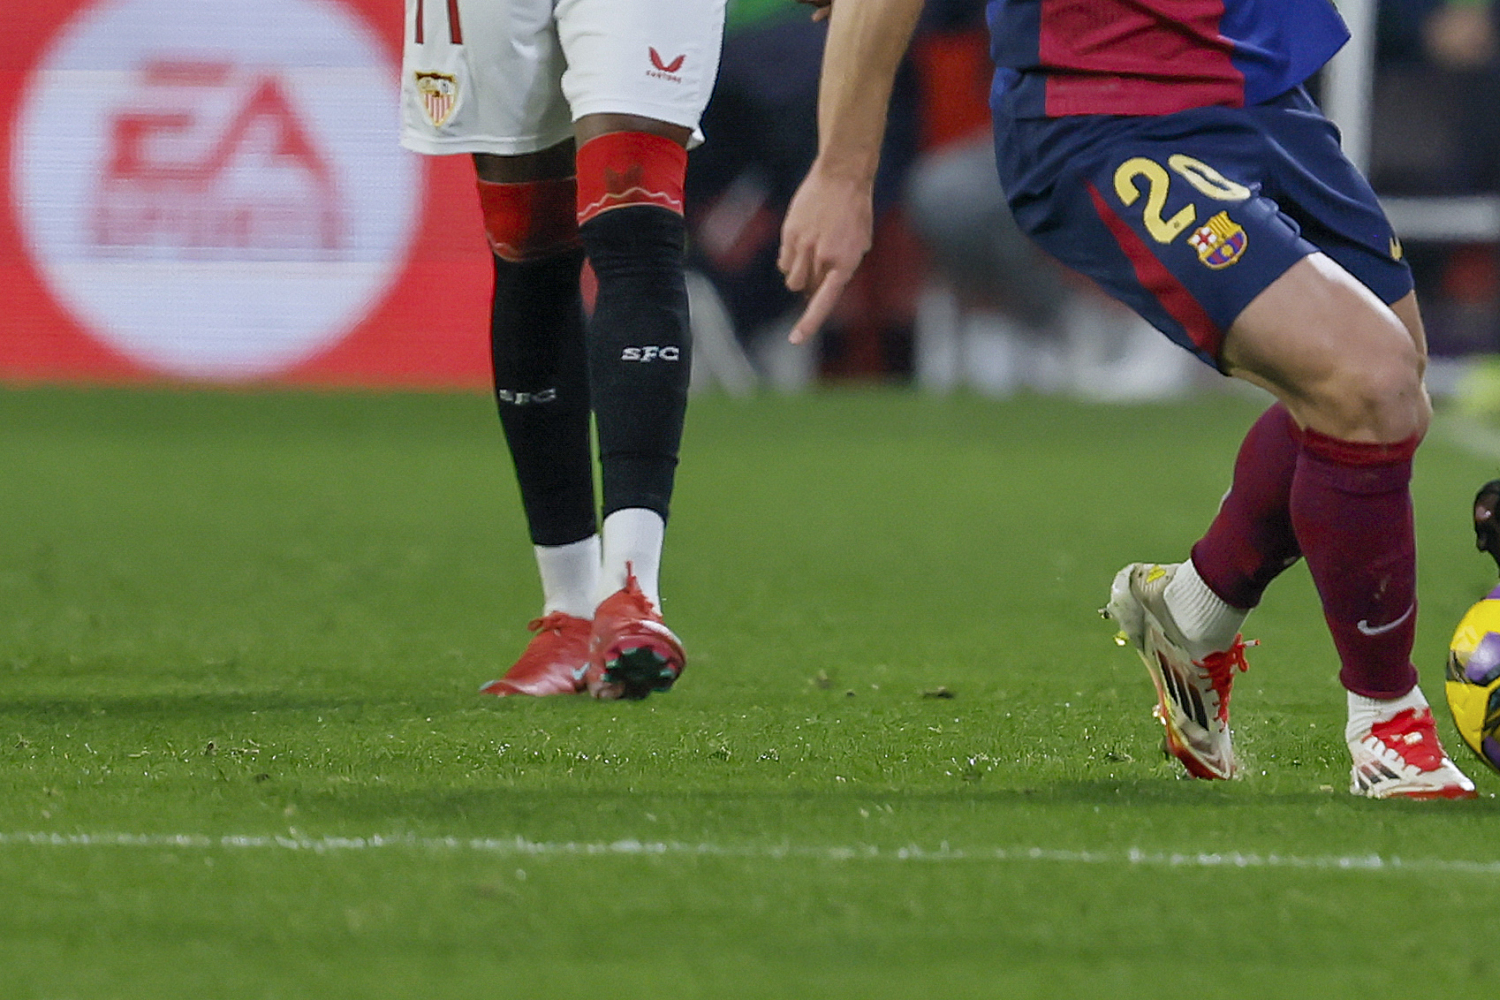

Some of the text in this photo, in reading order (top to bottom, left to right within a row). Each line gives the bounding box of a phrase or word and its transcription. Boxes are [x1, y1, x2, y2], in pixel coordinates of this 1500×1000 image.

[108, 58, 335, 192] EA
[1114, 154, 1251, 245] 20
[620, 346, 680, 363] SFC
